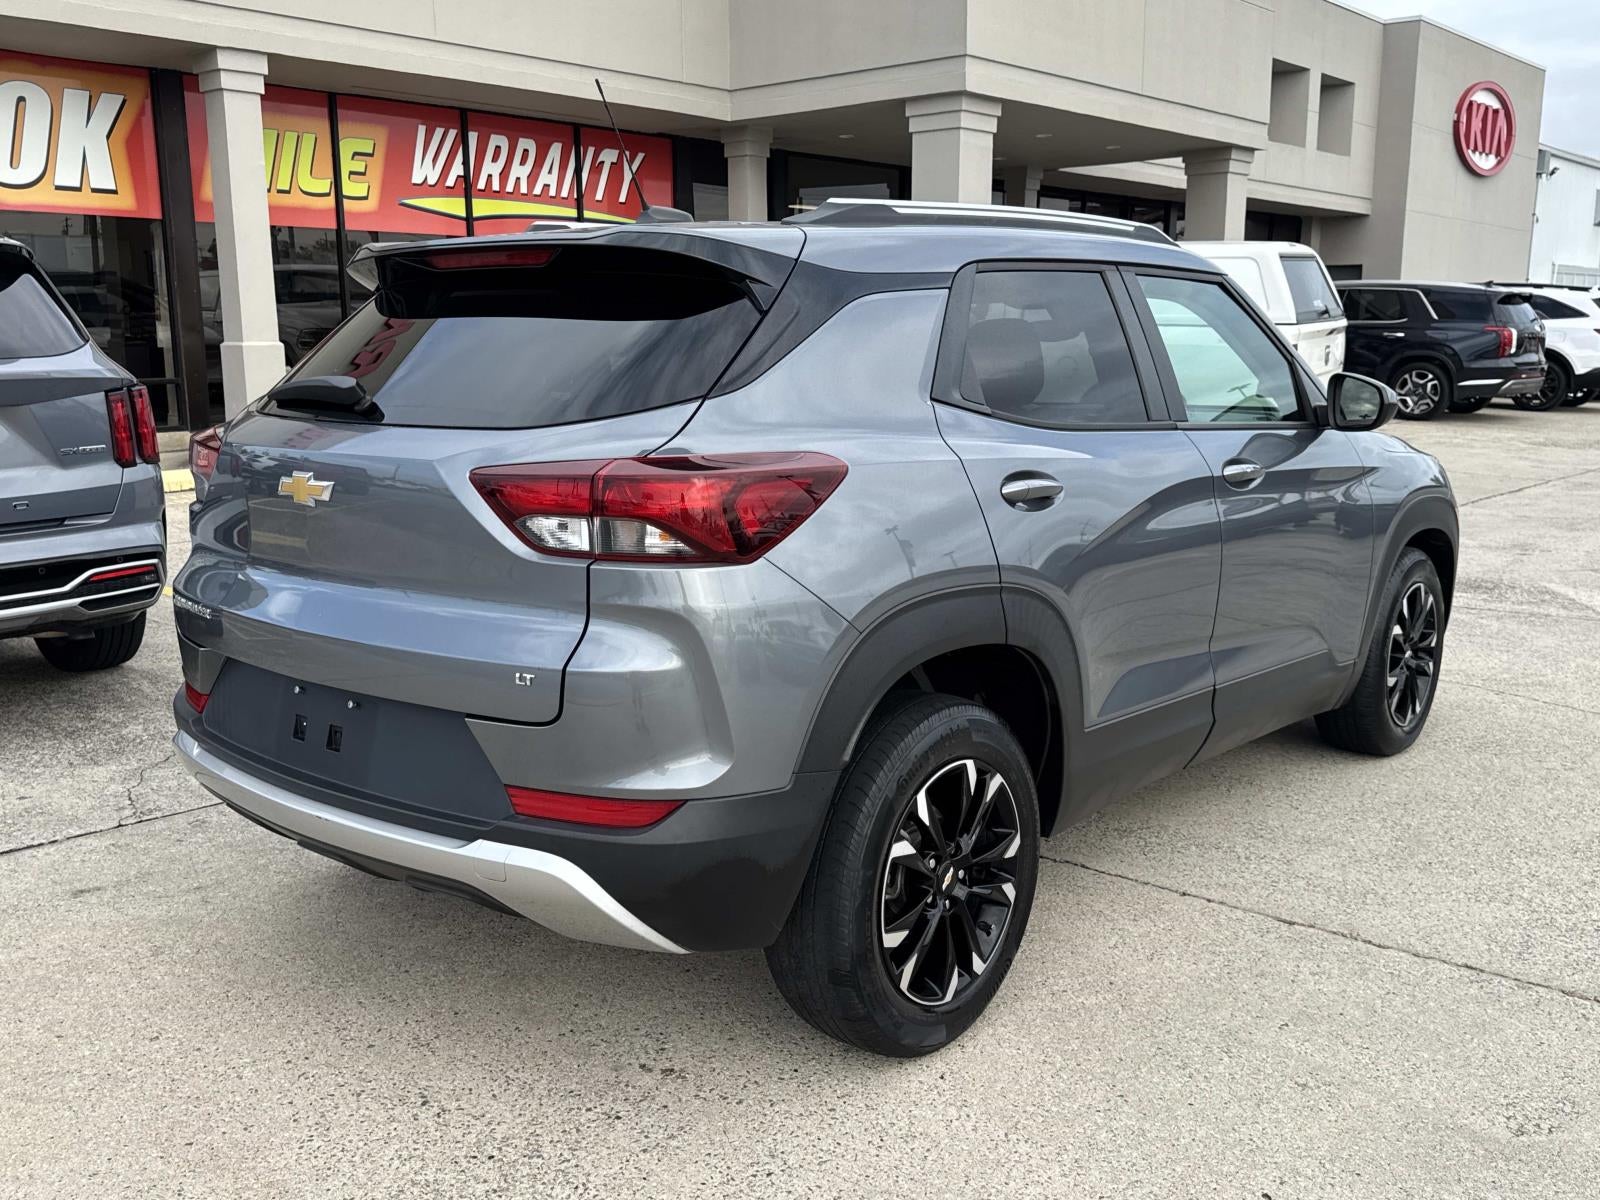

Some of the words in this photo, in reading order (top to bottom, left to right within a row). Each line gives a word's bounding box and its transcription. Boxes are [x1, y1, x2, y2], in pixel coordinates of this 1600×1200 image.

[1469, 100, 1506, 159] KIA
[262, 128, 376, 200] ILE
[411, 124, 646, 204] WARRANTY
[515, 672, 536, 687] LT
